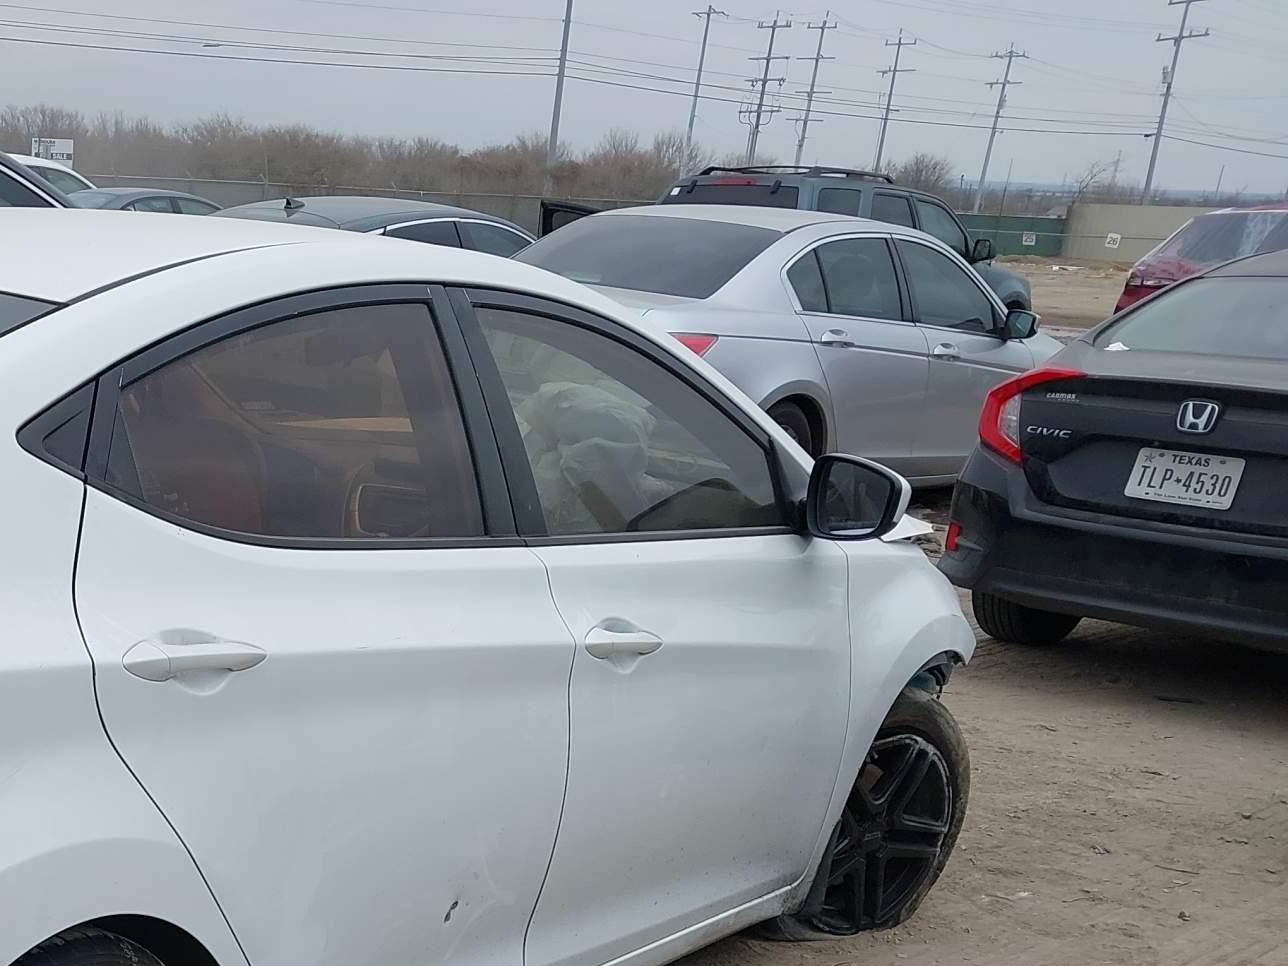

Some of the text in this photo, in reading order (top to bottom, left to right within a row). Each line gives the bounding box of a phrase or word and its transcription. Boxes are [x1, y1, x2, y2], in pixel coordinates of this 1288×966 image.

[1106, 236, 1119, 246] 26
[1026, 425, 1073, 438] CIVIC
[1171, 454, 1211, 467] TEXAS
